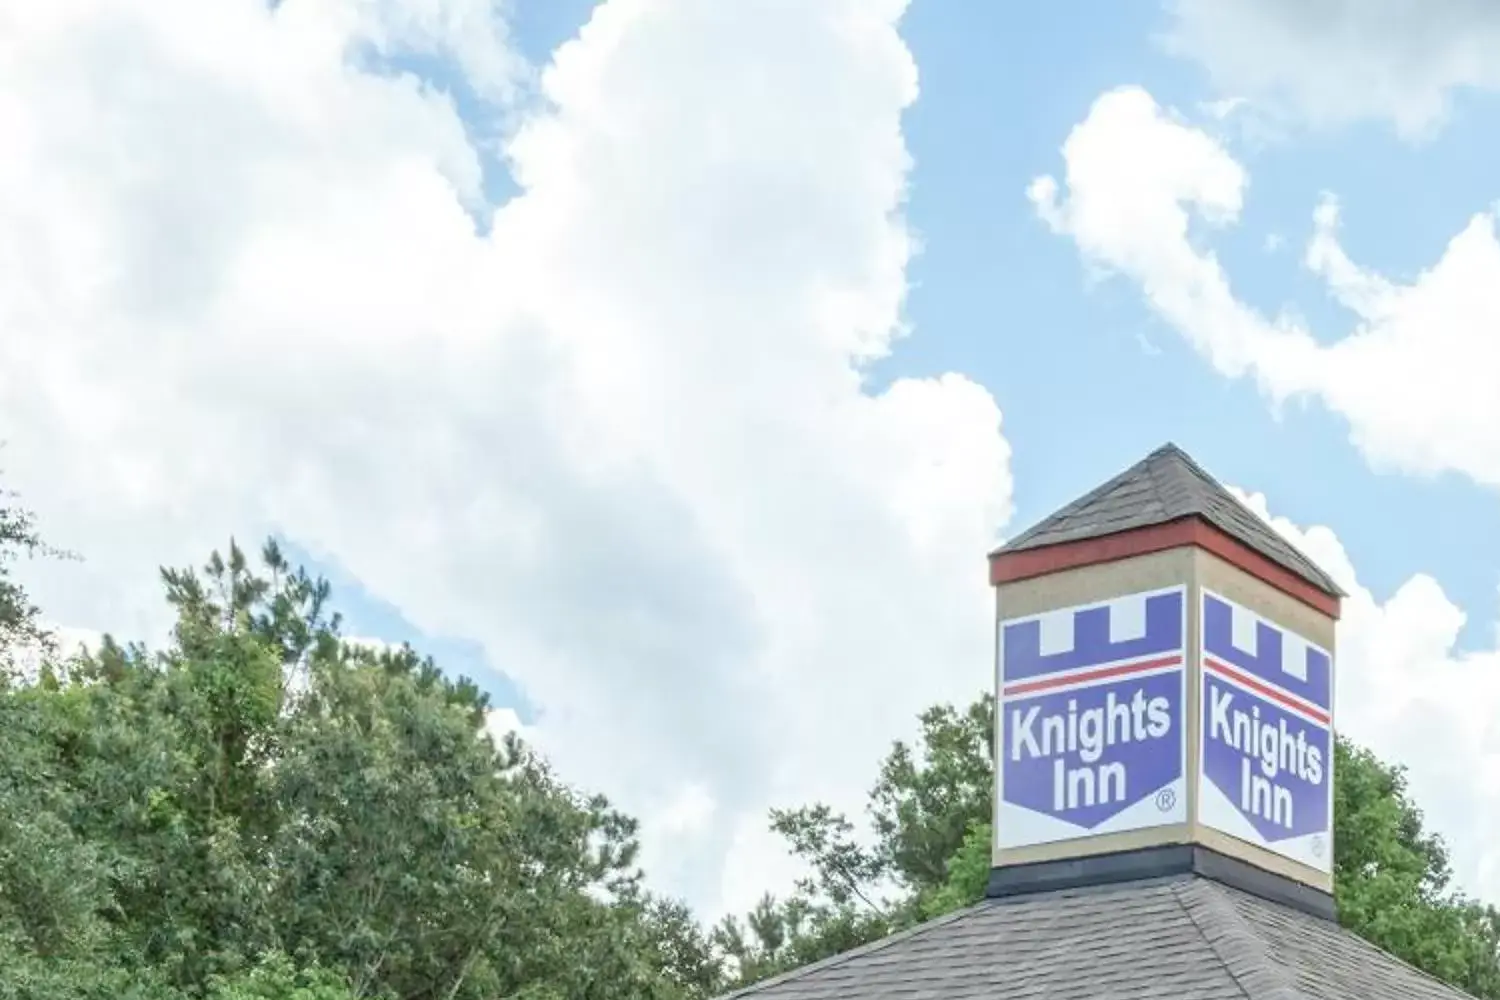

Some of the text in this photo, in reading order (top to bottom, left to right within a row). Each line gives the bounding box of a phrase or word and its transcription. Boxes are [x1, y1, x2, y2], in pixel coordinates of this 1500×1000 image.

[1011, 689, 1170, 762] Knights
[1211, 687, 1323, 785] Knights
[1054, 760, 1126, 811] Inn
[1241, 759, 1293, 828] Inn
